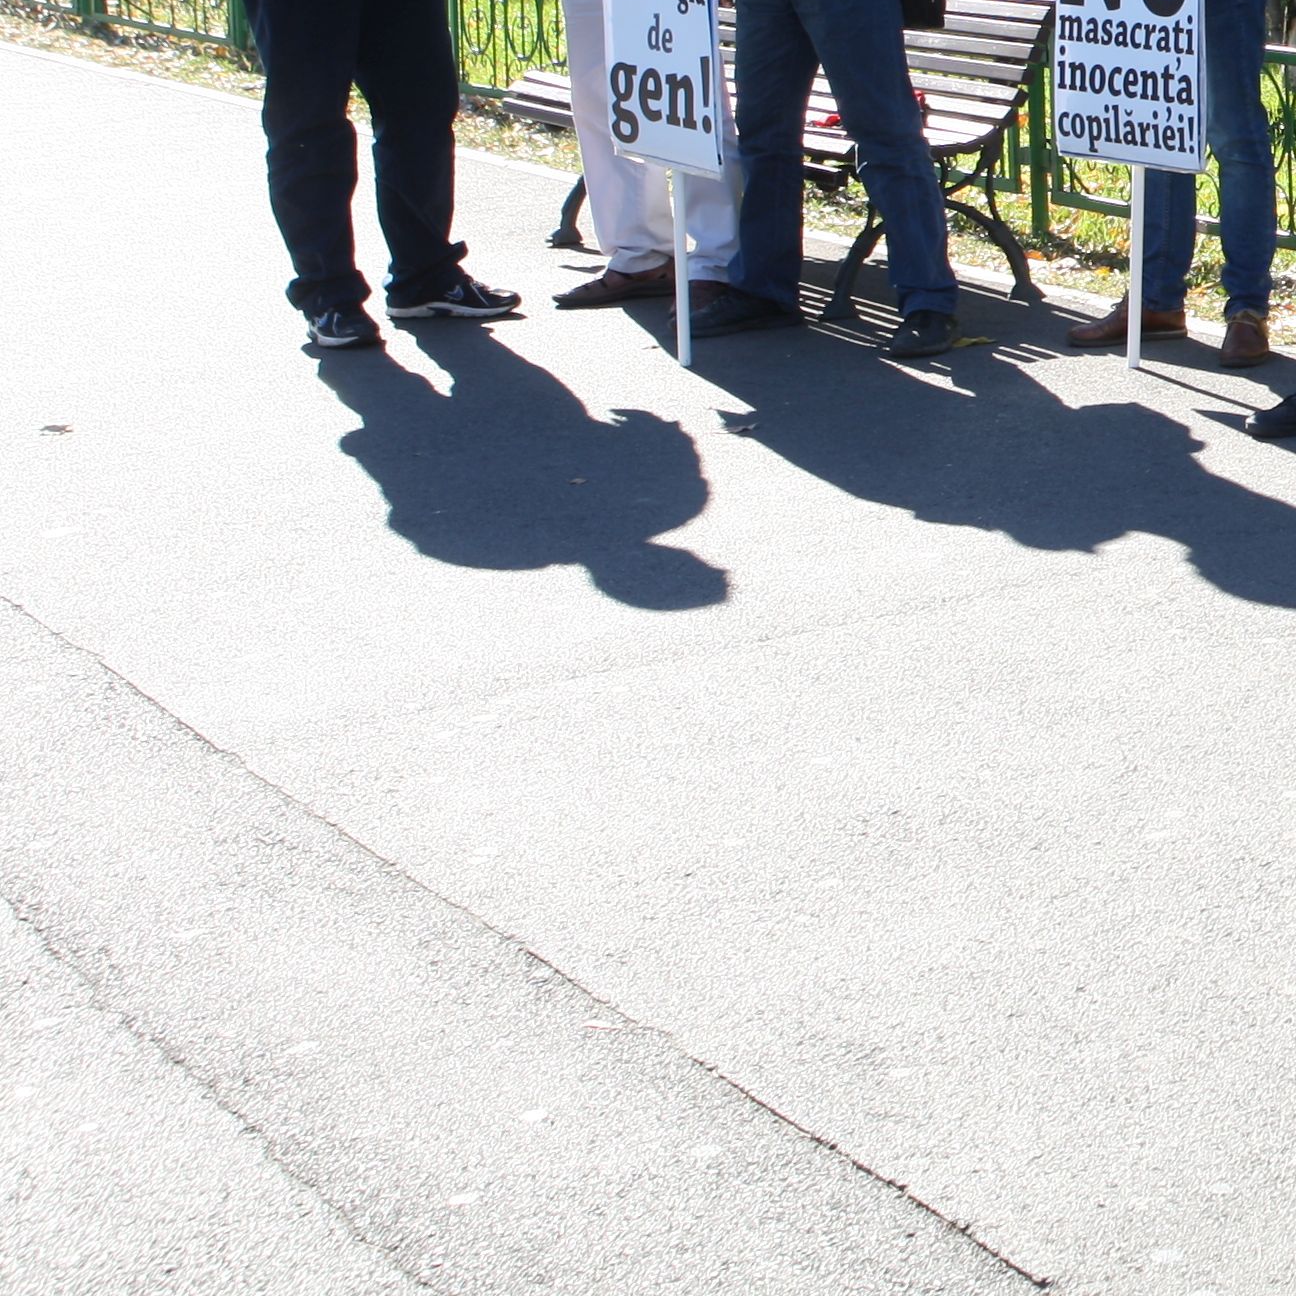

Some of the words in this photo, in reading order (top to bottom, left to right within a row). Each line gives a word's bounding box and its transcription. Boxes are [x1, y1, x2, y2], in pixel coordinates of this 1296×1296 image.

[646, 12, 674, 54] de
[1058, 14, 1195, 72] masacrați
[609, 55, 713, 145] gen!
[1057, 45, 1195, 122] inocența
[1057, 103, 1196, 155] copilăriei!
